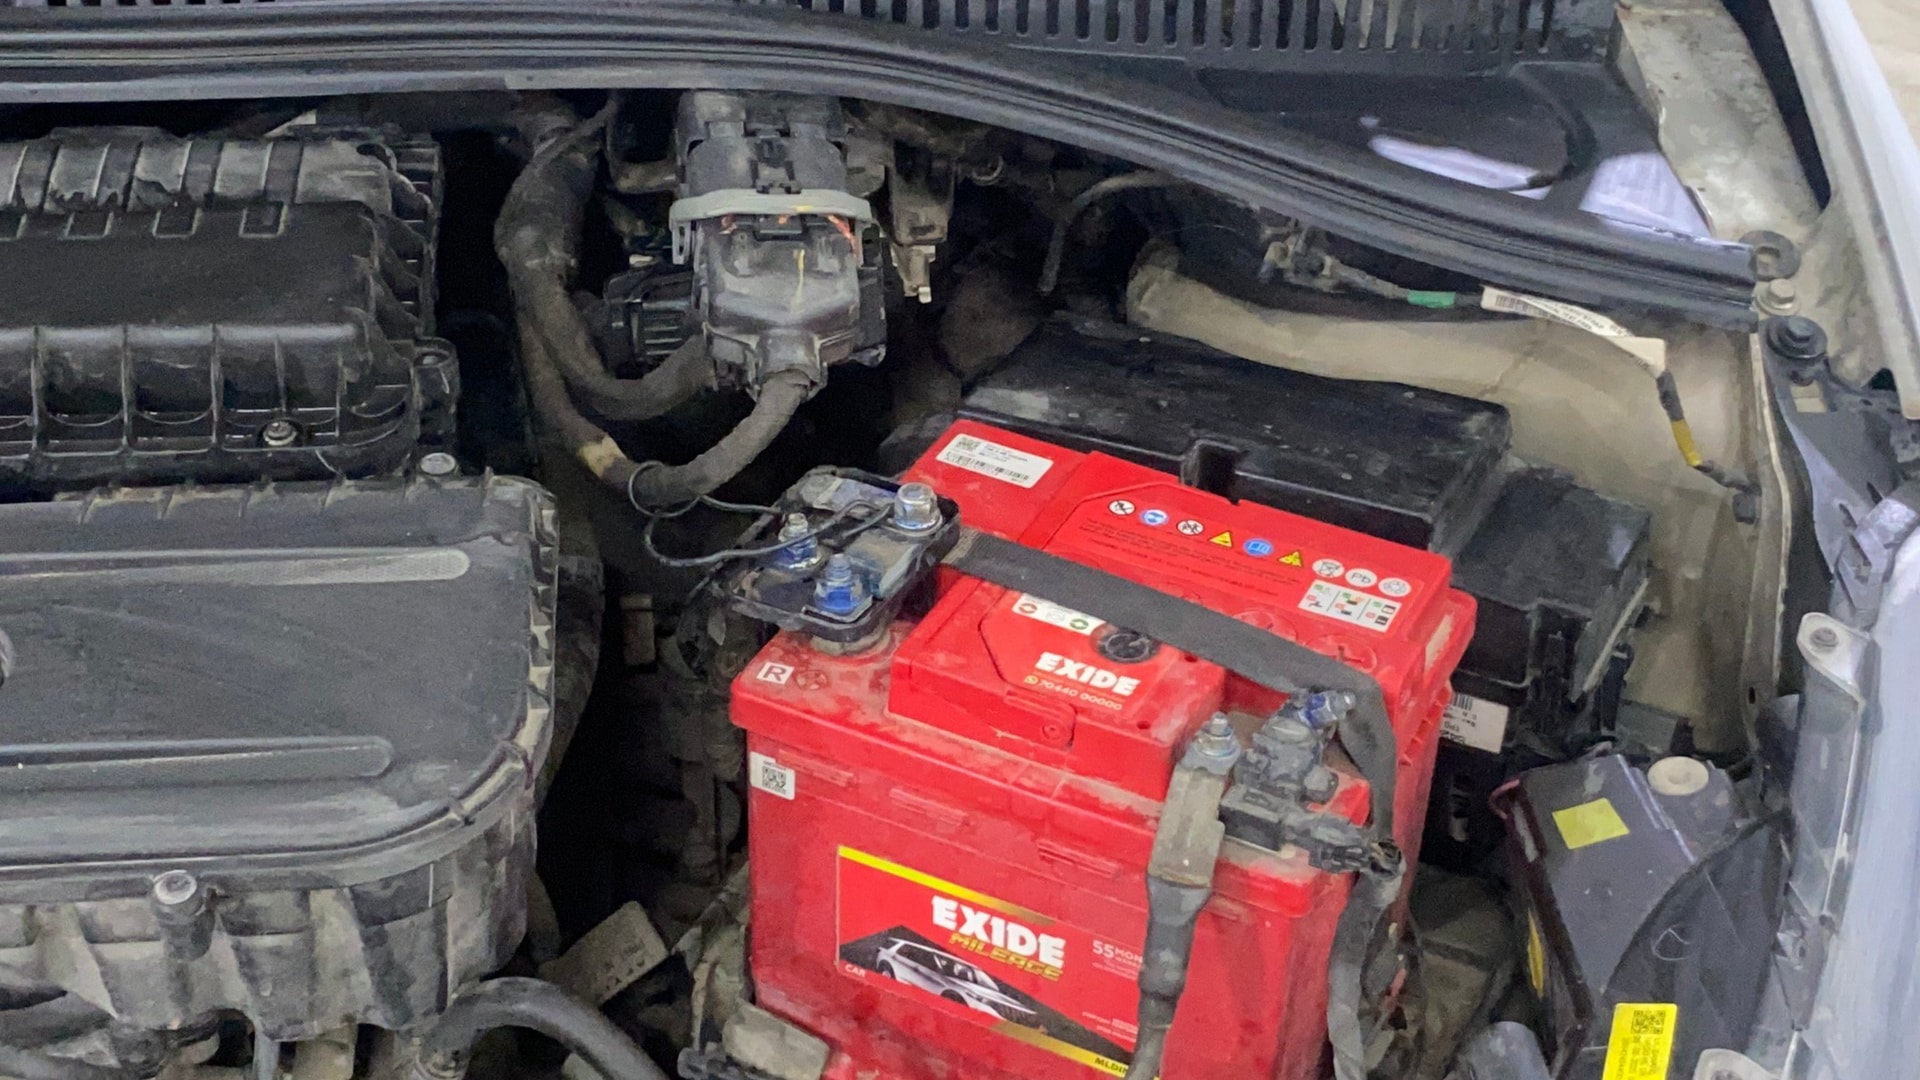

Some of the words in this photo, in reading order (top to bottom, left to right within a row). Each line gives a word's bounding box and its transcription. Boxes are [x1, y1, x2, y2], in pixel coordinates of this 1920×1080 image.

[1351, 572, 1372, 584] Pb
[763, 666, 787, 682] R
[1035, 651, 1141, 696] EXIDE
[1039, 680, 1078, 696] 70440
[1080, 693, 1122, 710] 00000
[931, 895, 1066, 968] EXIDE
[949, 933, 1064, 982] MILEAGE
[1092, 939, 1115, 959] 55
[845, 963, 866, 978] CAR
